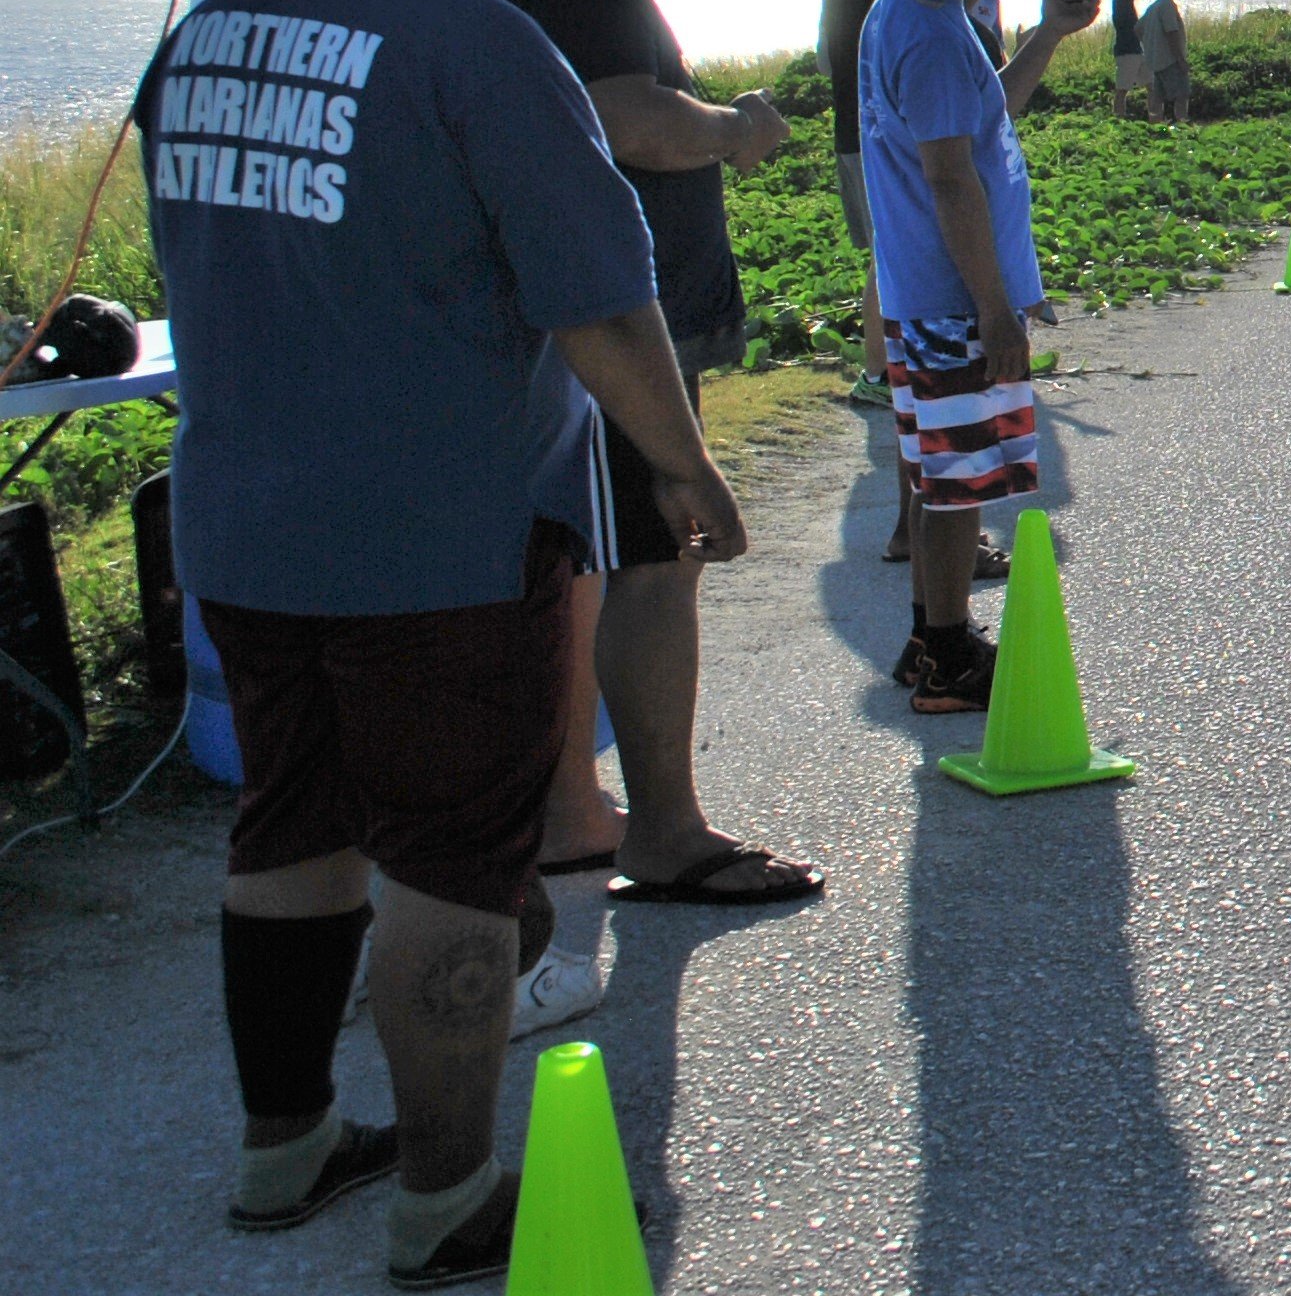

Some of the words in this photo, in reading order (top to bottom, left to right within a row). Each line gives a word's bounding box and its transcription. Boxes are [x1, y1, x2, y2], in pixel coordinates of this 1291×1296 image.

[169, 10, 384, 89] NORTHERN
[160, 76, 358, 155] MARIANAS
[155, 142, 347, 224] ATHLETICS
